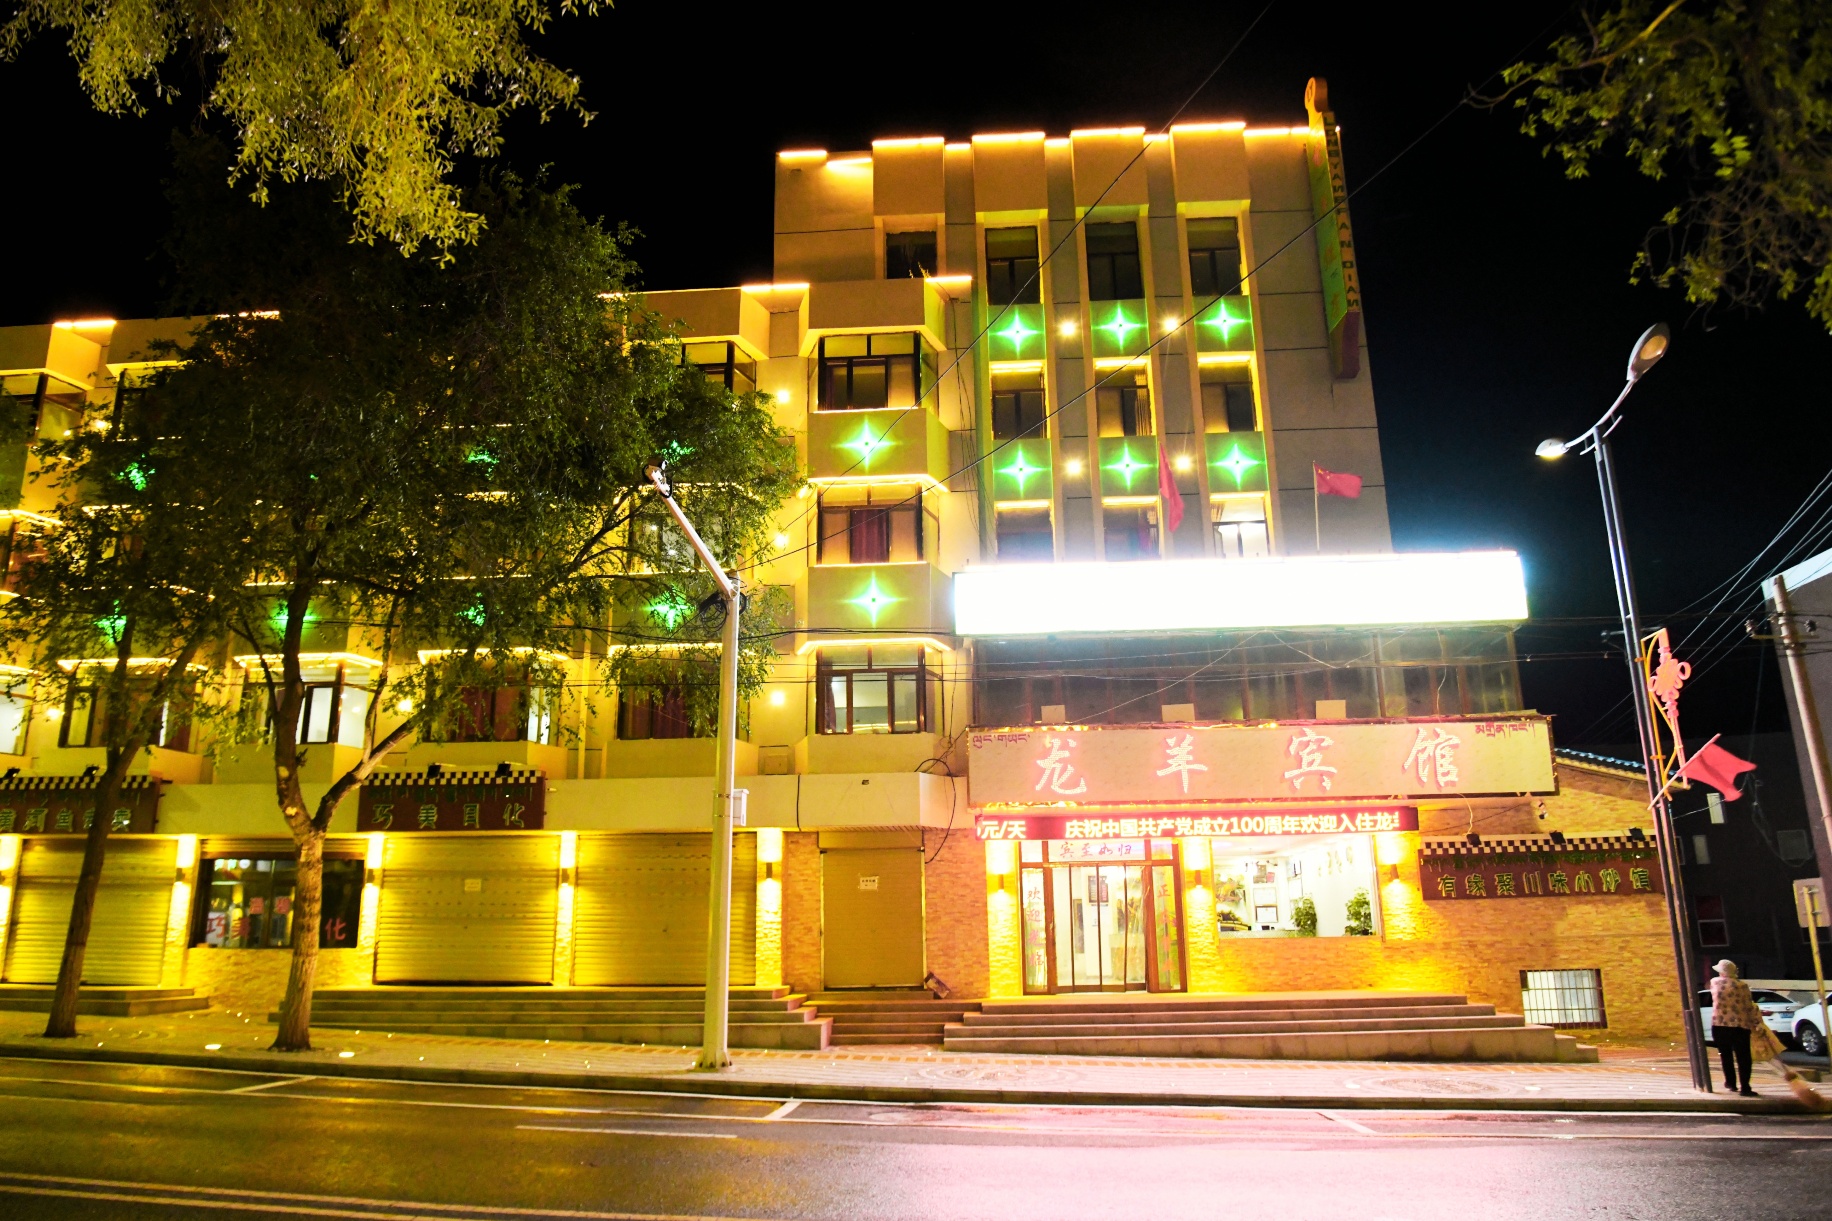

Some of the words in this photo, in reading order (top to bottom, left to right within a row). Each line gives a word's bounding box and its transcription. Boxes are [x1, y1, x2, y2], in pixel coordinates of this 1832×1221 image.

[1036, 727, 1461, 795] 龙羊宾馆
[372, 803, 525, 830] 巧美目化
[975, 820, 1027, 839] 元/天
[1060, 841, 1132, 858] 宾至如归
